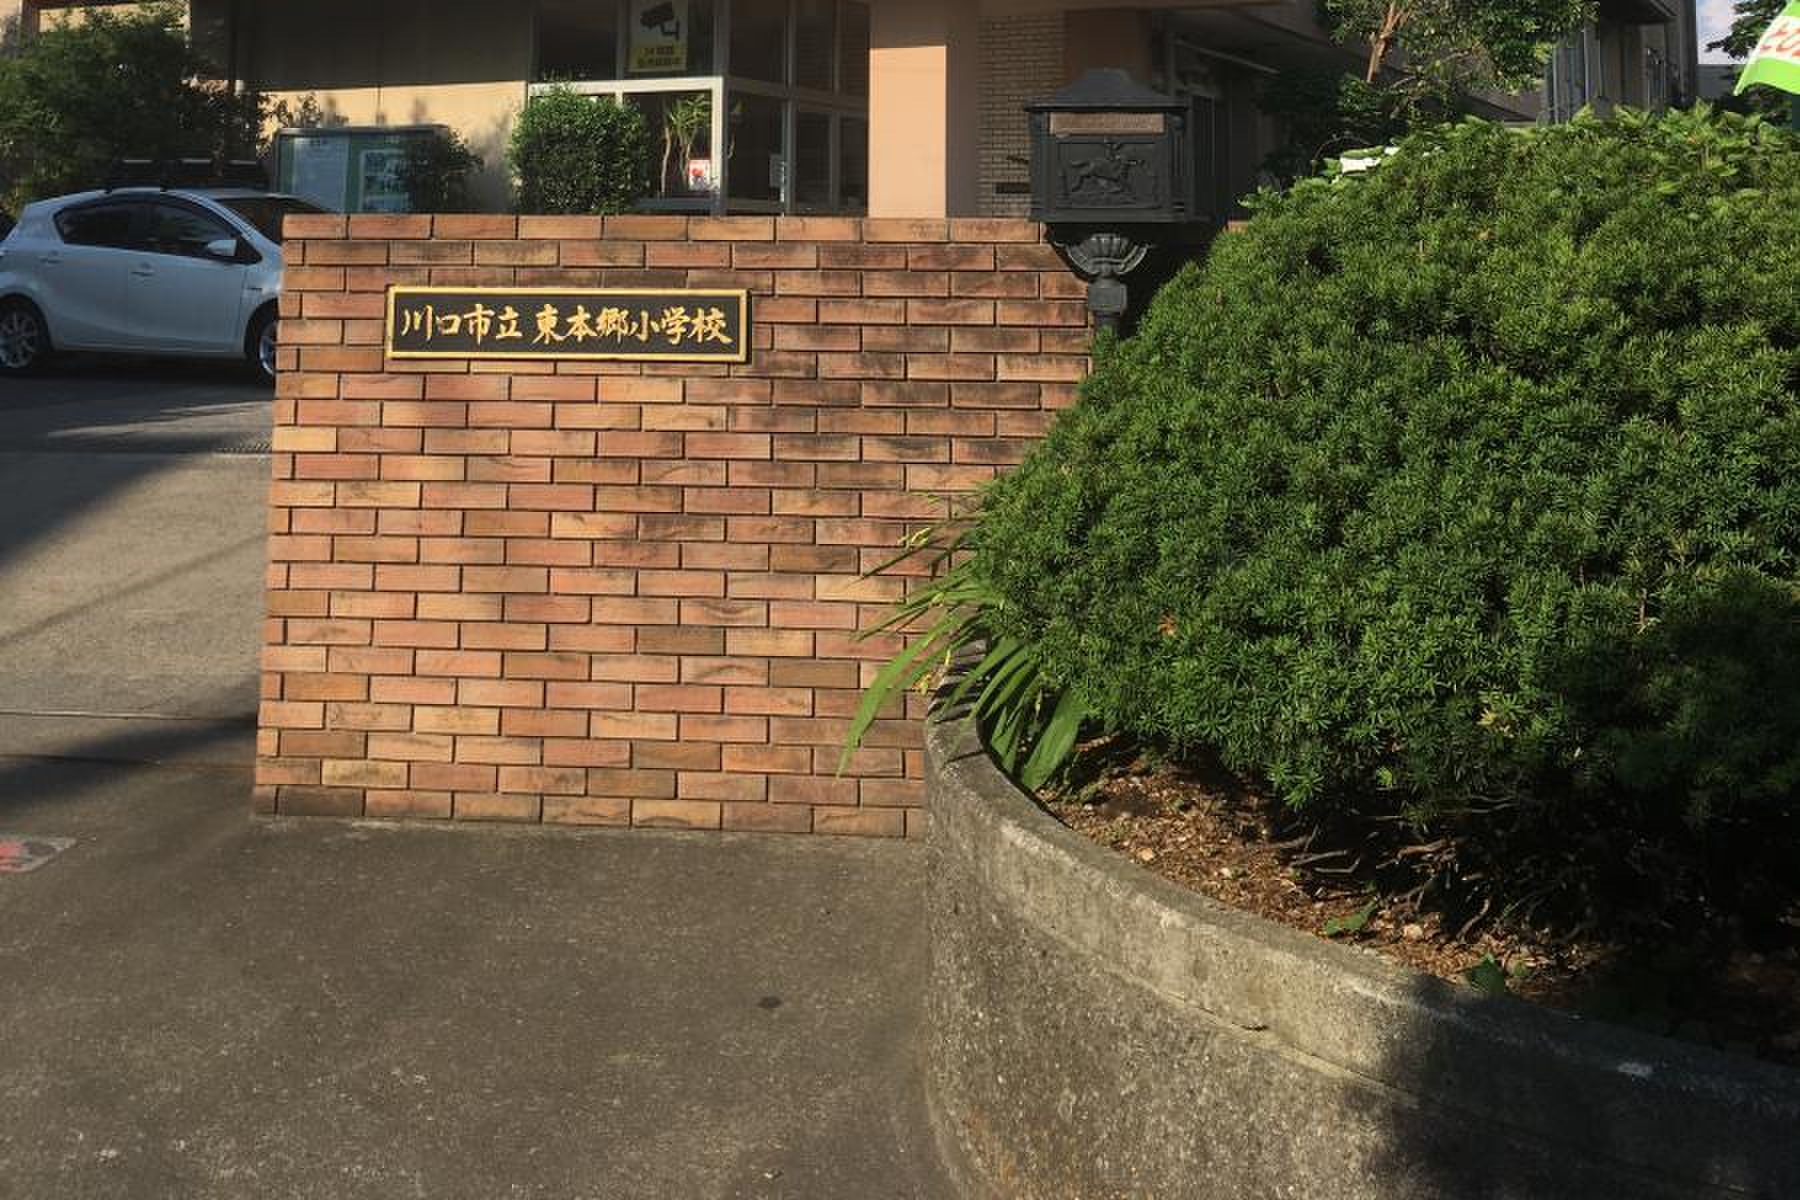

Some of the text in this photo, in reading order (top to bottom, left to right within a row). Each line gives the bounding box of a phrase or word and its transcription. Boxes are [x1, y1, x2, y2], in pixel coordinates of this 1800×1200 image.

[401, 303, 733, 345] 川口市立 東本郷小学校
